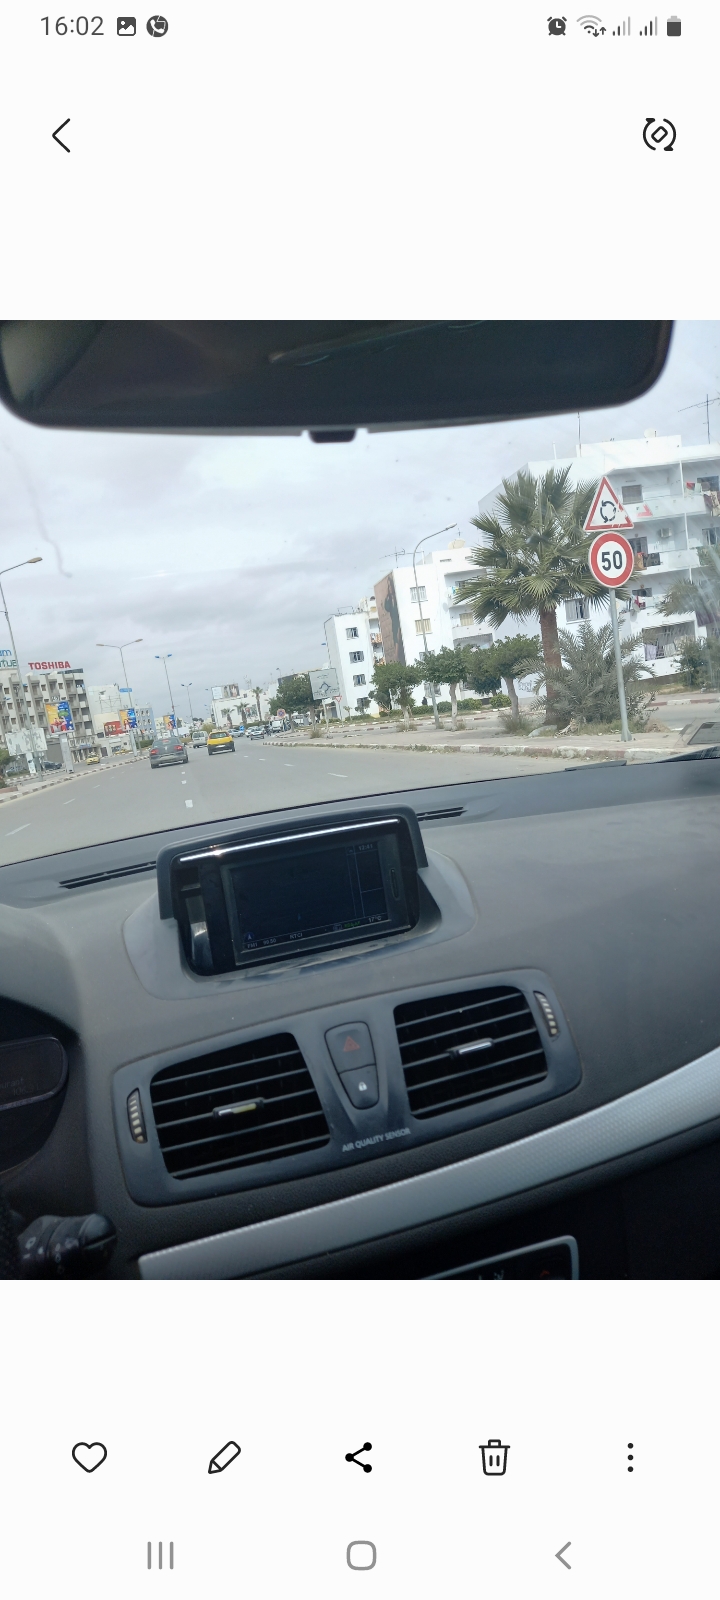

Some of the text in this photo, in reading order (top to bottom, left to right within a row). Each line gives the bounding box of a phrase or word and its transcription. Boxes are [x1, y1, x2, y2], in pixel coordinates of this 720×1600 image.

[601, 550, 623, 571] 50
[28, 661, 71, 670] TOSHIBA
[342, 1127, 411, 1152] AIR QUALITY SENSOR
